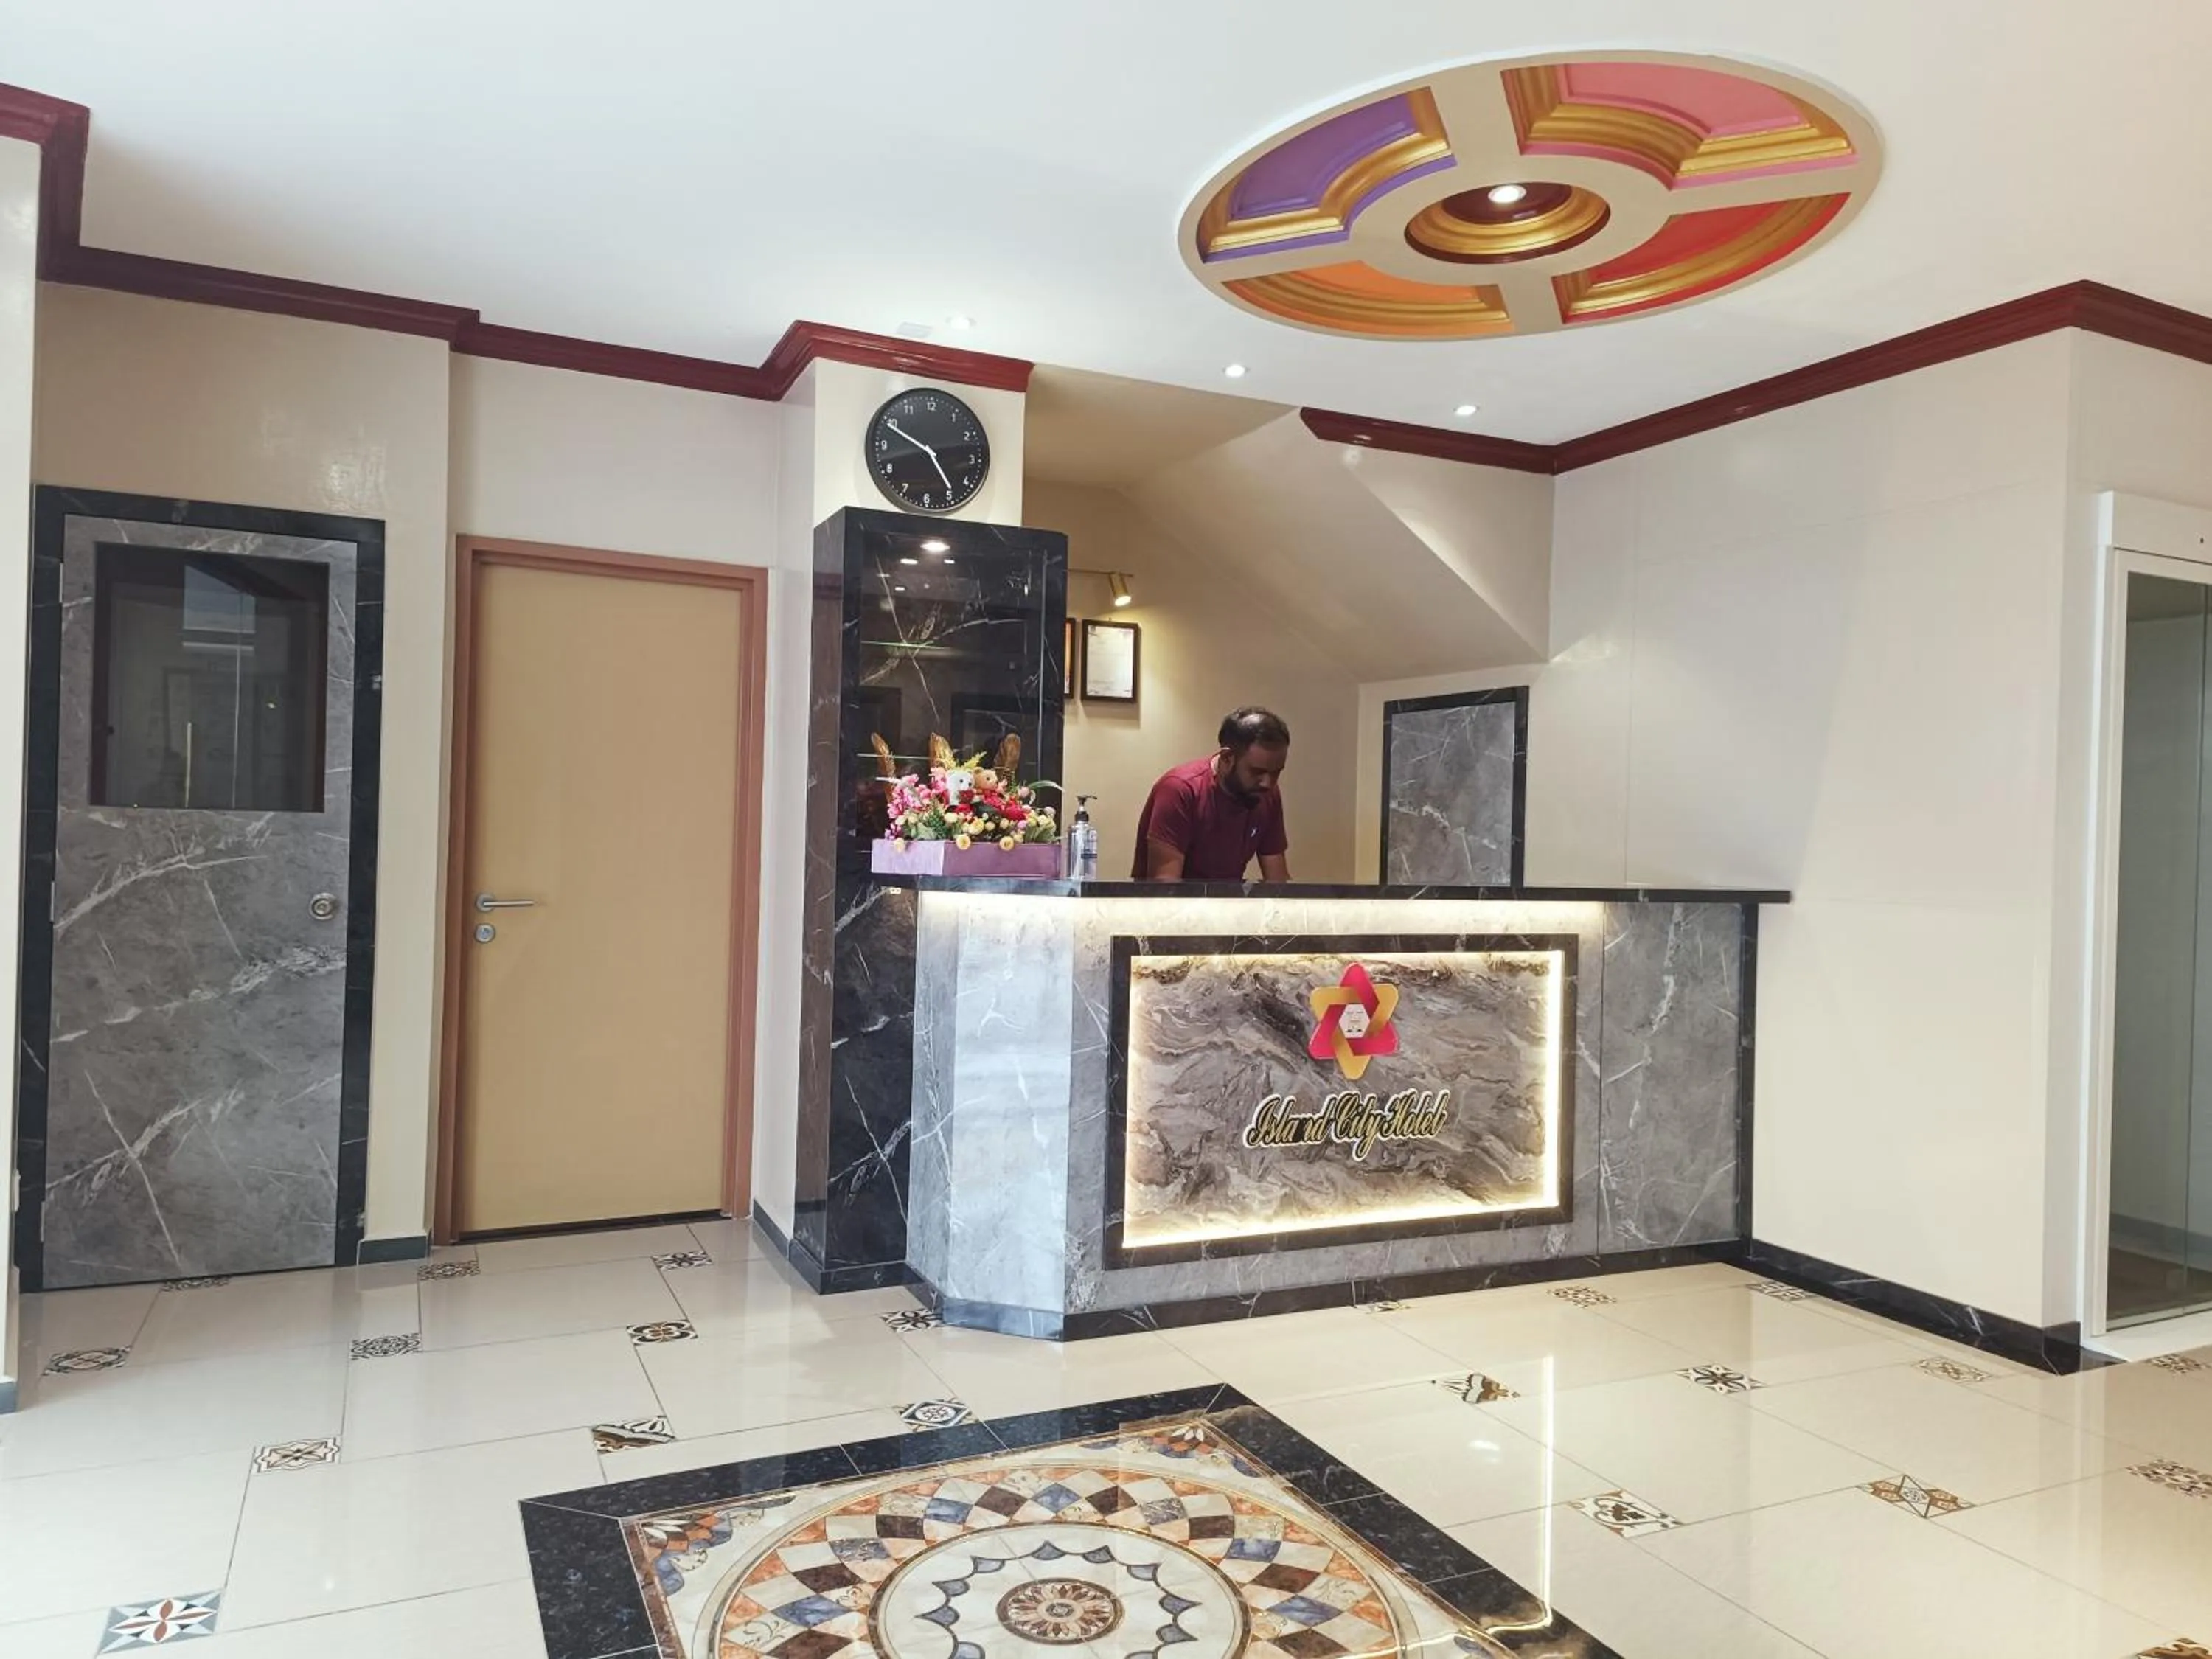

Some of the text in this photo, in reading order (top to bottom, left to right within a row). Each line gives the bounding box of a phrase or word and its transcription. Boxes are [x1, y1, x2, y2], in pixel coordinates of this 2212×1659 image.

[904, 406, 914, 414] 11
[927, 402, 936, 411] 12
[964, 431, 970, 441] 2
[881, 441, 887, 450] 9
[886, 463, 892, 473] 8
[963, 476, 968, 485] 4
[902, 484, 908, 493] 7
[923, 494, 930, 503] 6
[946, 491, 952, 500] 5
[1247, 1091, 1449, 1158] Island City Hotel
